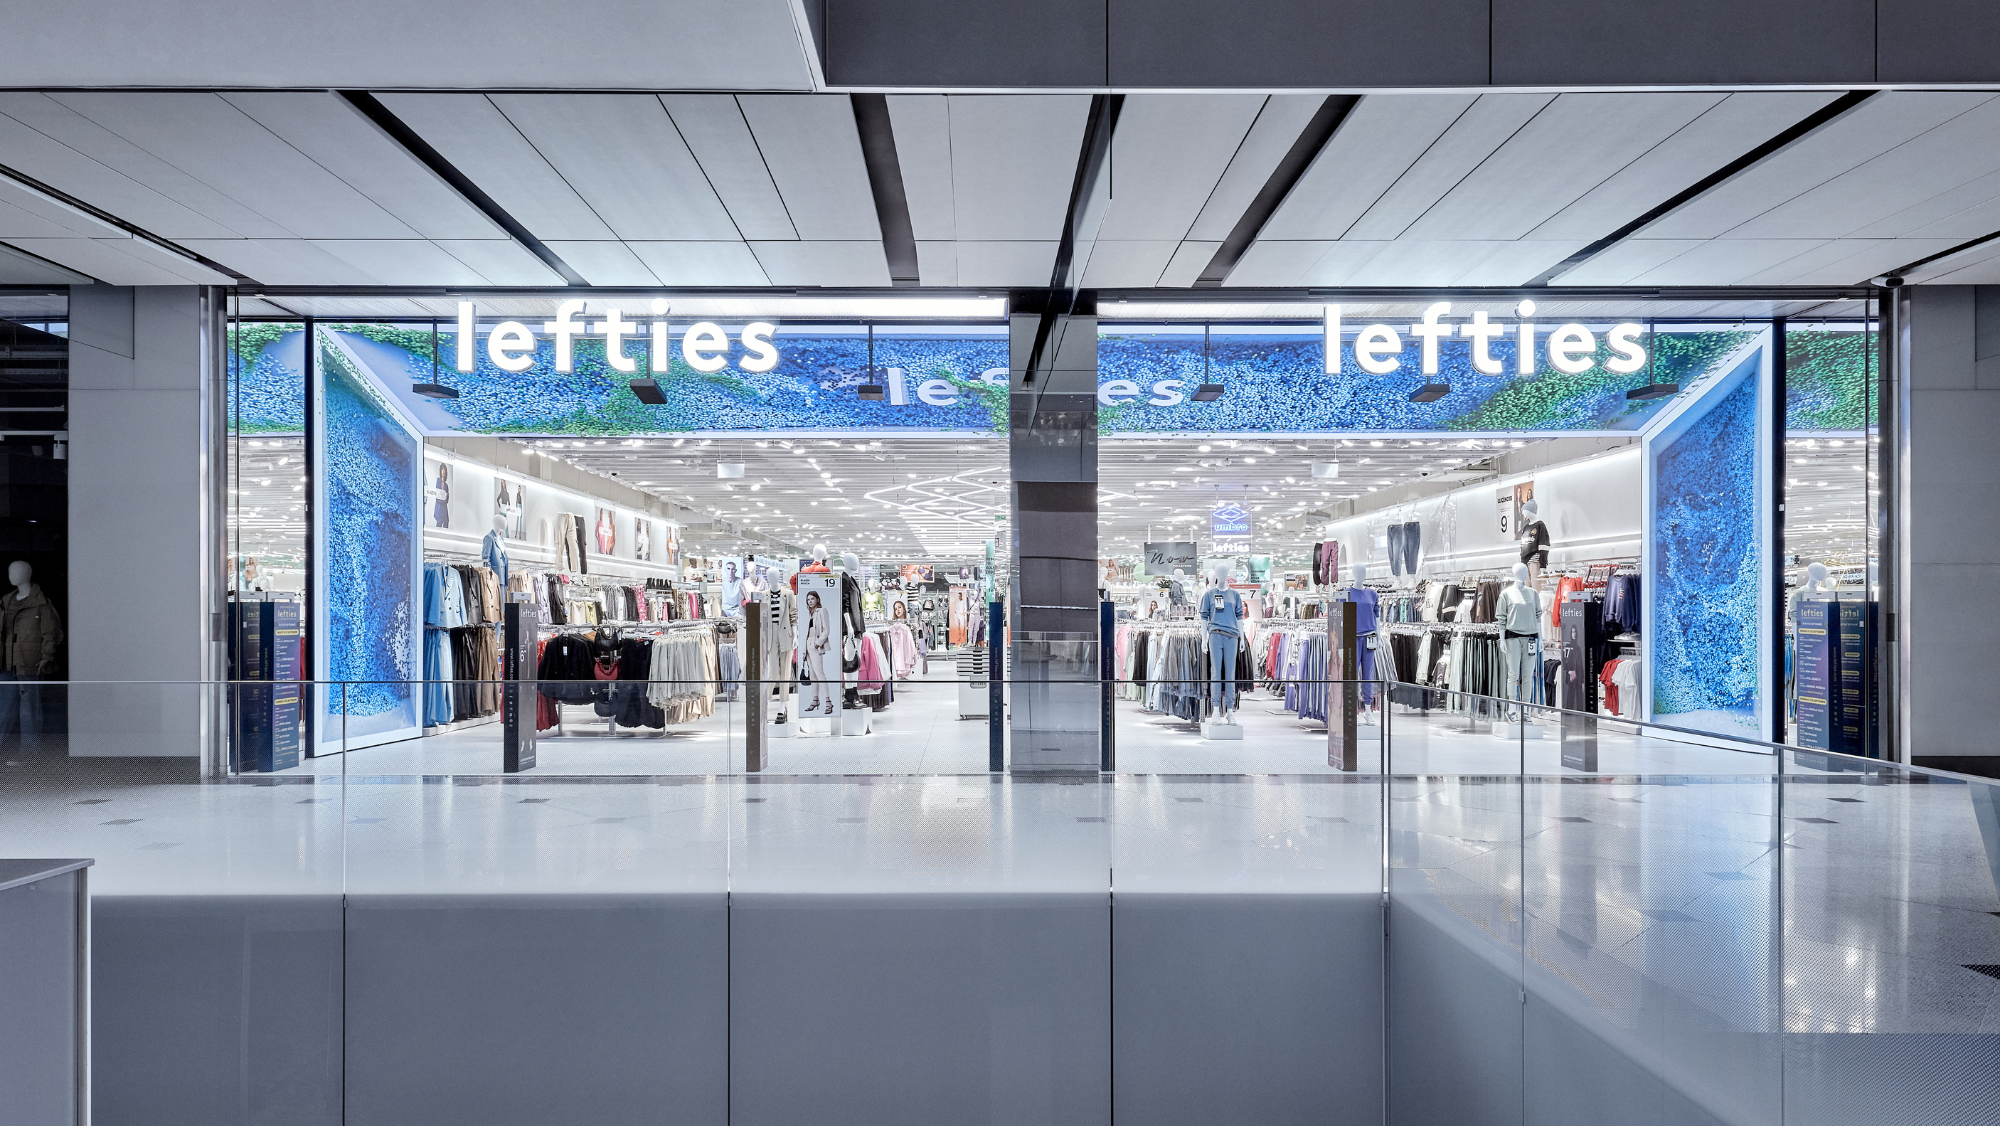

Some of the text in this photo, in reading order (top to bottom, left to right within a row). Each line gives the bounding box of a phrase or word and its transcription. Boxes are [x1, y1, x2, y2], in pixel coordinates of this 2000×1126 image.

[457, 298, 780, 374] lefties
[1323, 299, 1649, 375] lefties
[1214, 523, 1249, 532] umbro
[1501, 516, 1508, 533] 9
[1213, 542, 1250, 553] lefties
[824, 578, 836, 588] 19
[1249, 589, 1257, 599] 7
[277, 609, 297, 618] lefties
[520, 608, 537, 618] lefties
[1562, 608, 1583, 618] lefties
[1801, 608, 1824, 617] lefties
